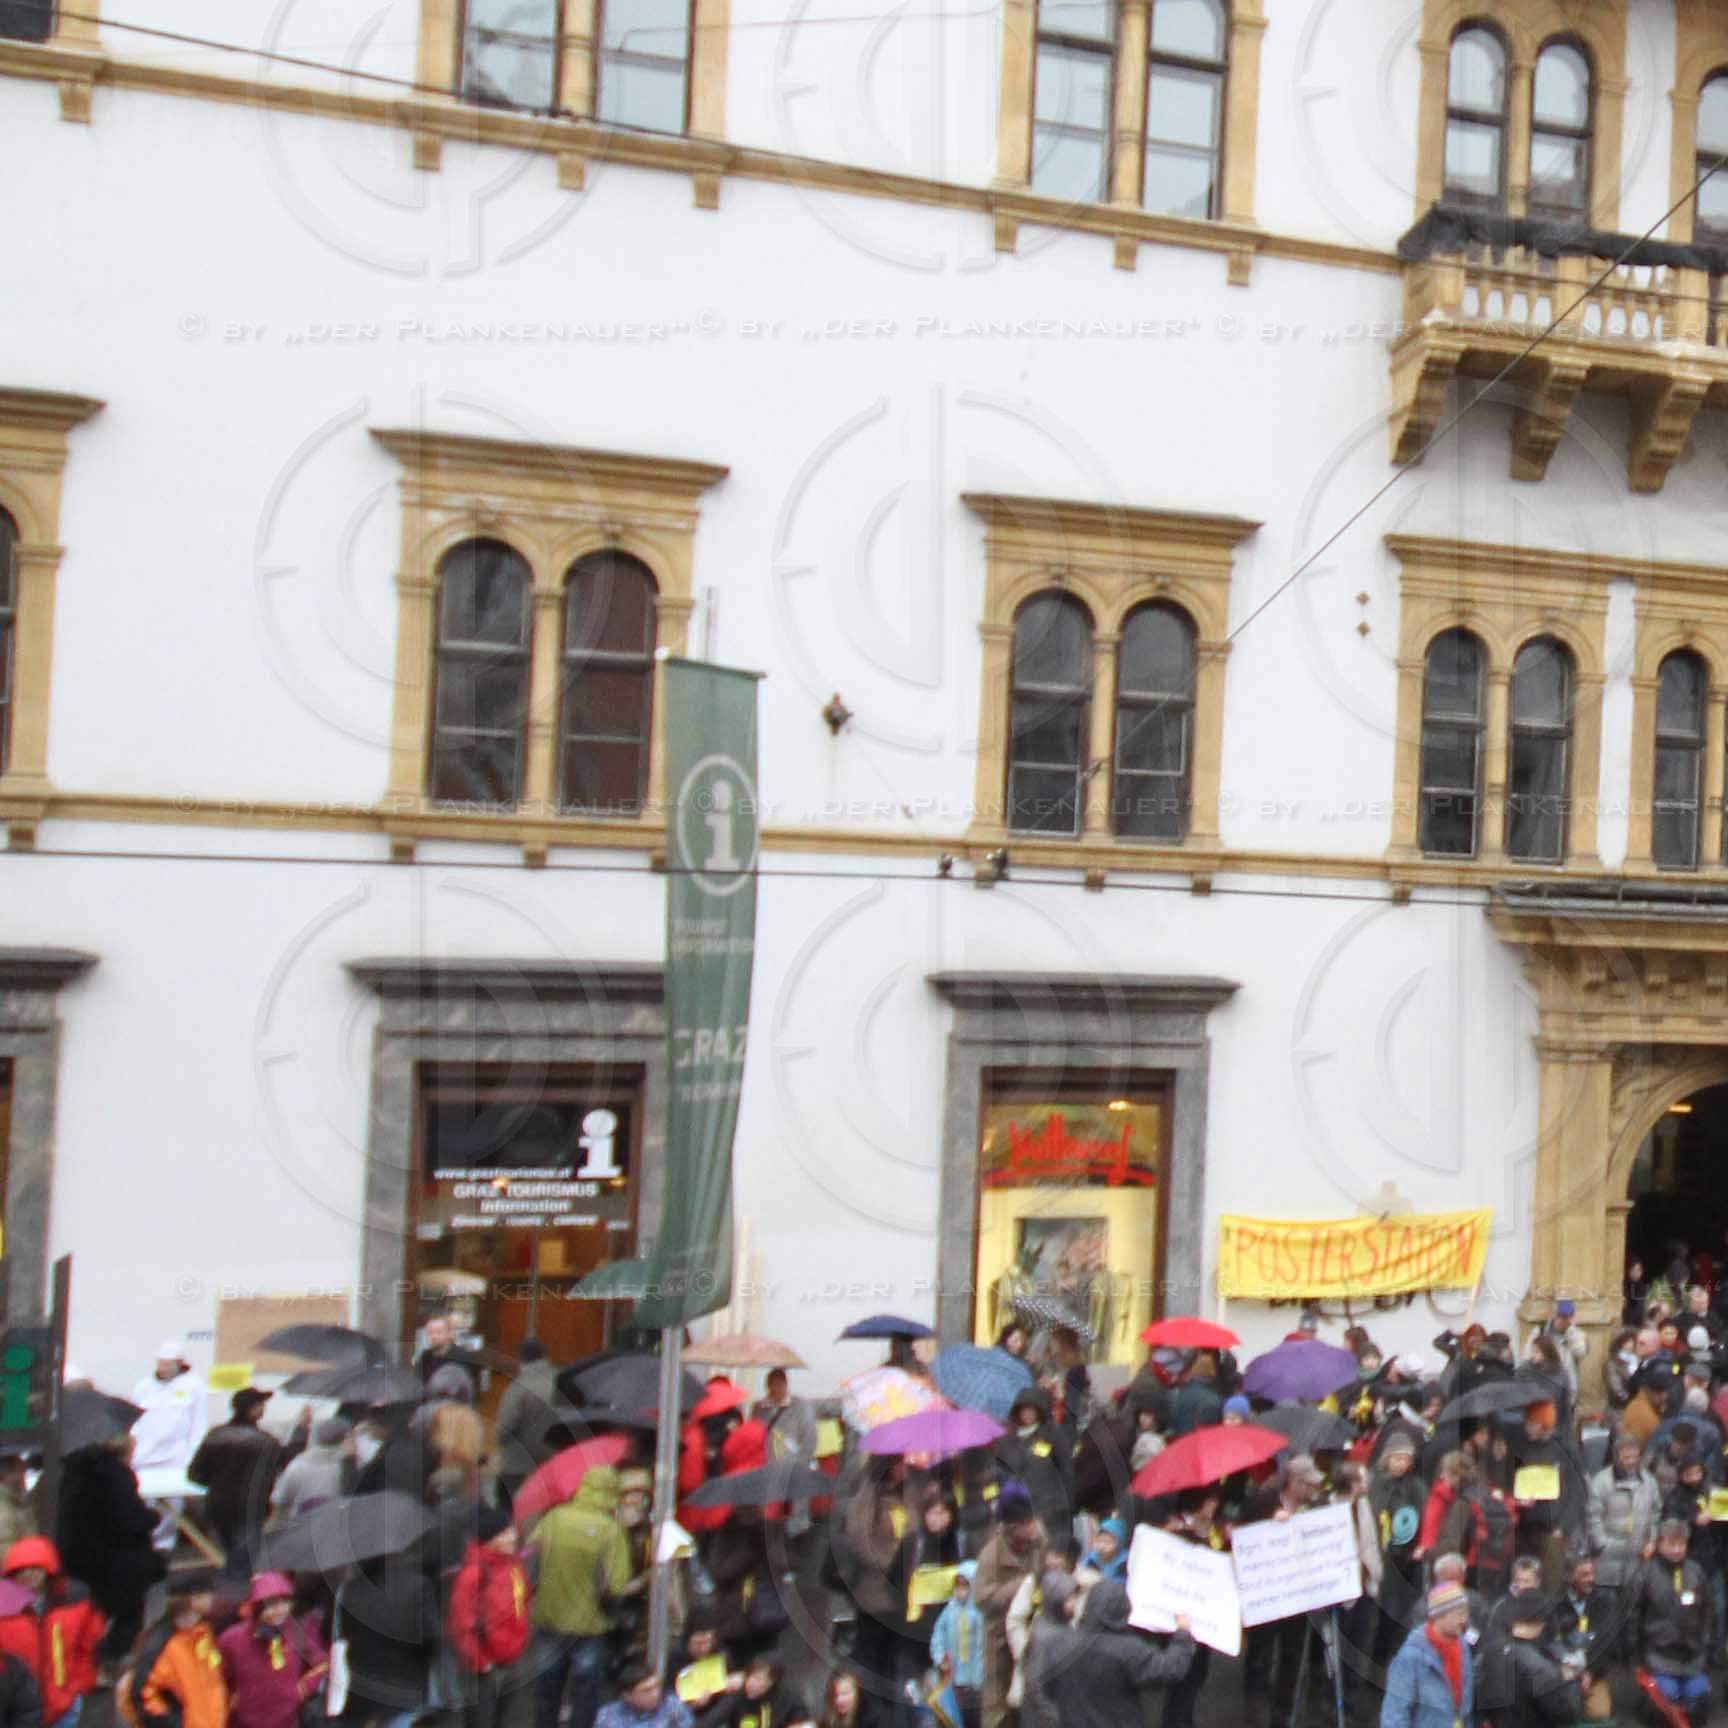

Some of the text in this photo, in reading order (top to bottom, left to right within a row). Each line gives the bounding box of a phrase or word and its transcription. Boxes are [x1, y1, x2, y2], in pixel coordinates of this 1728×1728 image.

[704, 779, 738, 870] i
[576, 1108, 622, 1178] i
[507, 1182, 598, 1198] TOURISMUS
